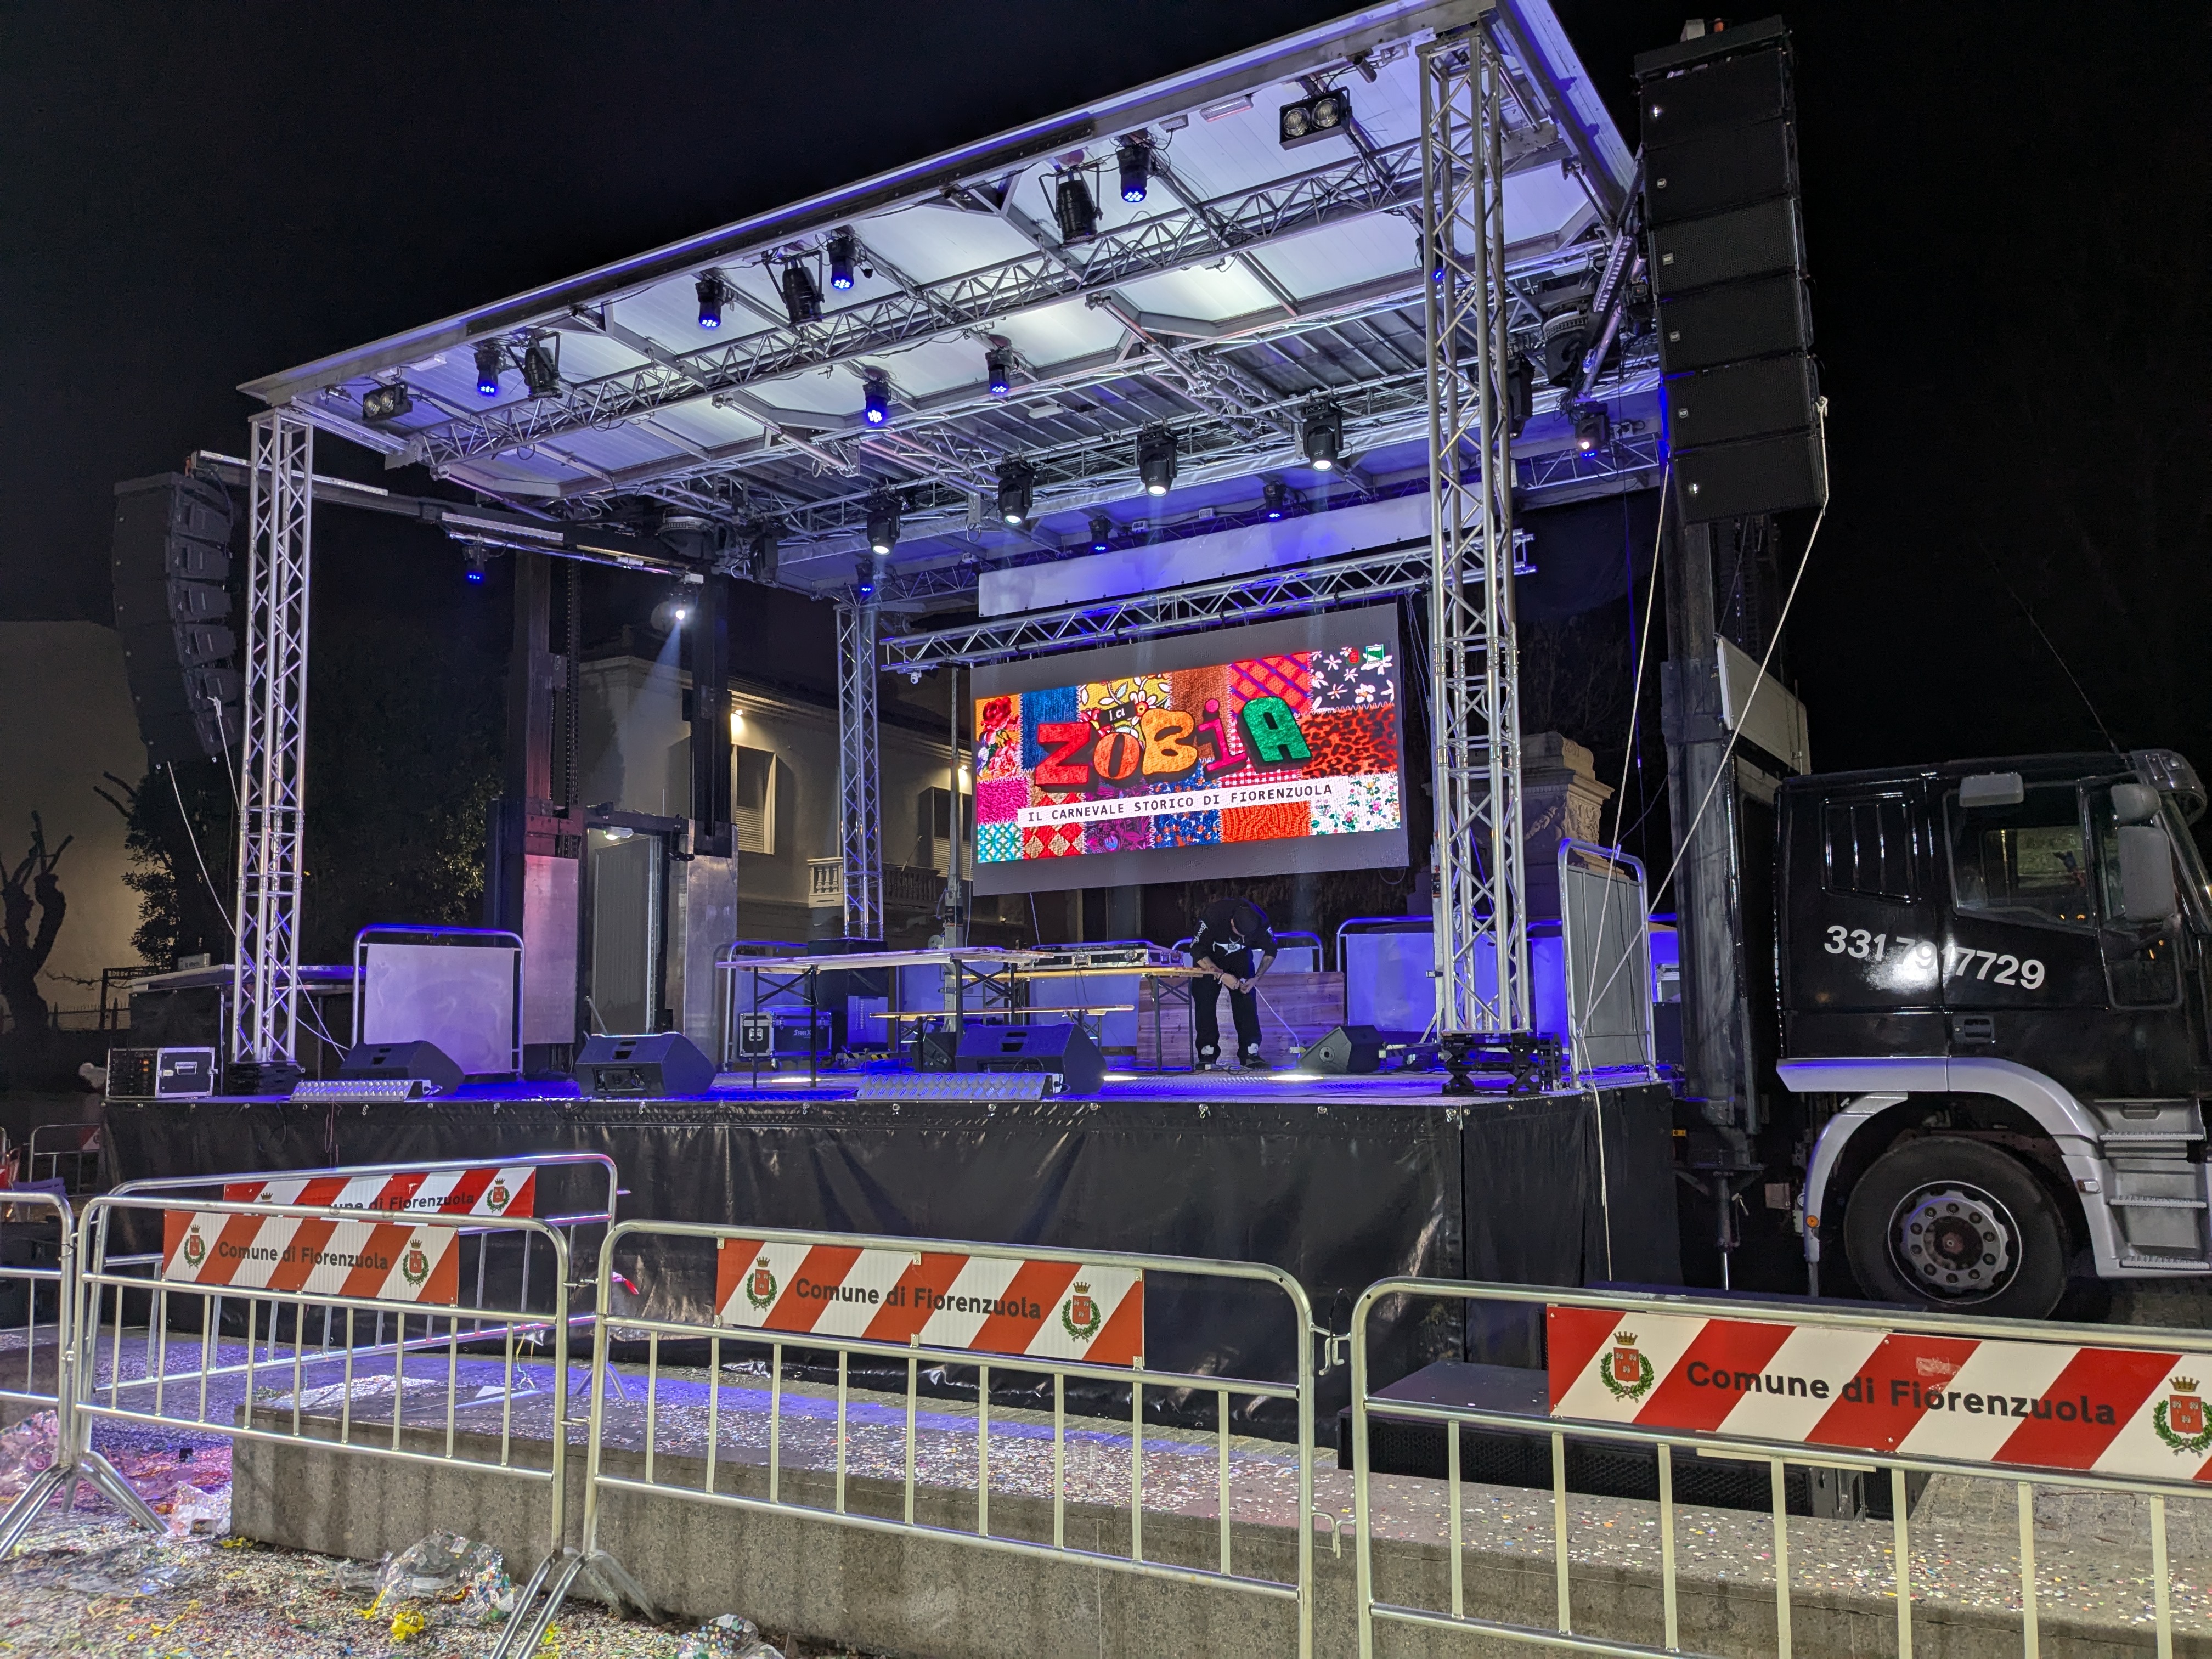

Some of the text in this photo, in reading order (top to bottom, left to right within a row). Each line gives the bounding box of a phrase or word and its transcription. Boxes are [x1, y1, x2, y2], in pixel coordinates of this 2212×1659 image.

[1028, 783, 1333, 822] IL CARNEVALE STORICO DI FIORENZUOLA
[1824, 925, 1886, 961] 331
[369, 1197, 383, 1210] di
[390, 1190, 475, 1210] Fiorenzuola
[219, 1242, 388, 1271] Comune di Fiorenzuola
[796, 1278, 1041, 1319] Comune di Fiorenzuola
[1686, 1361, 2117, 1426] Comune di Fiorenzuola
